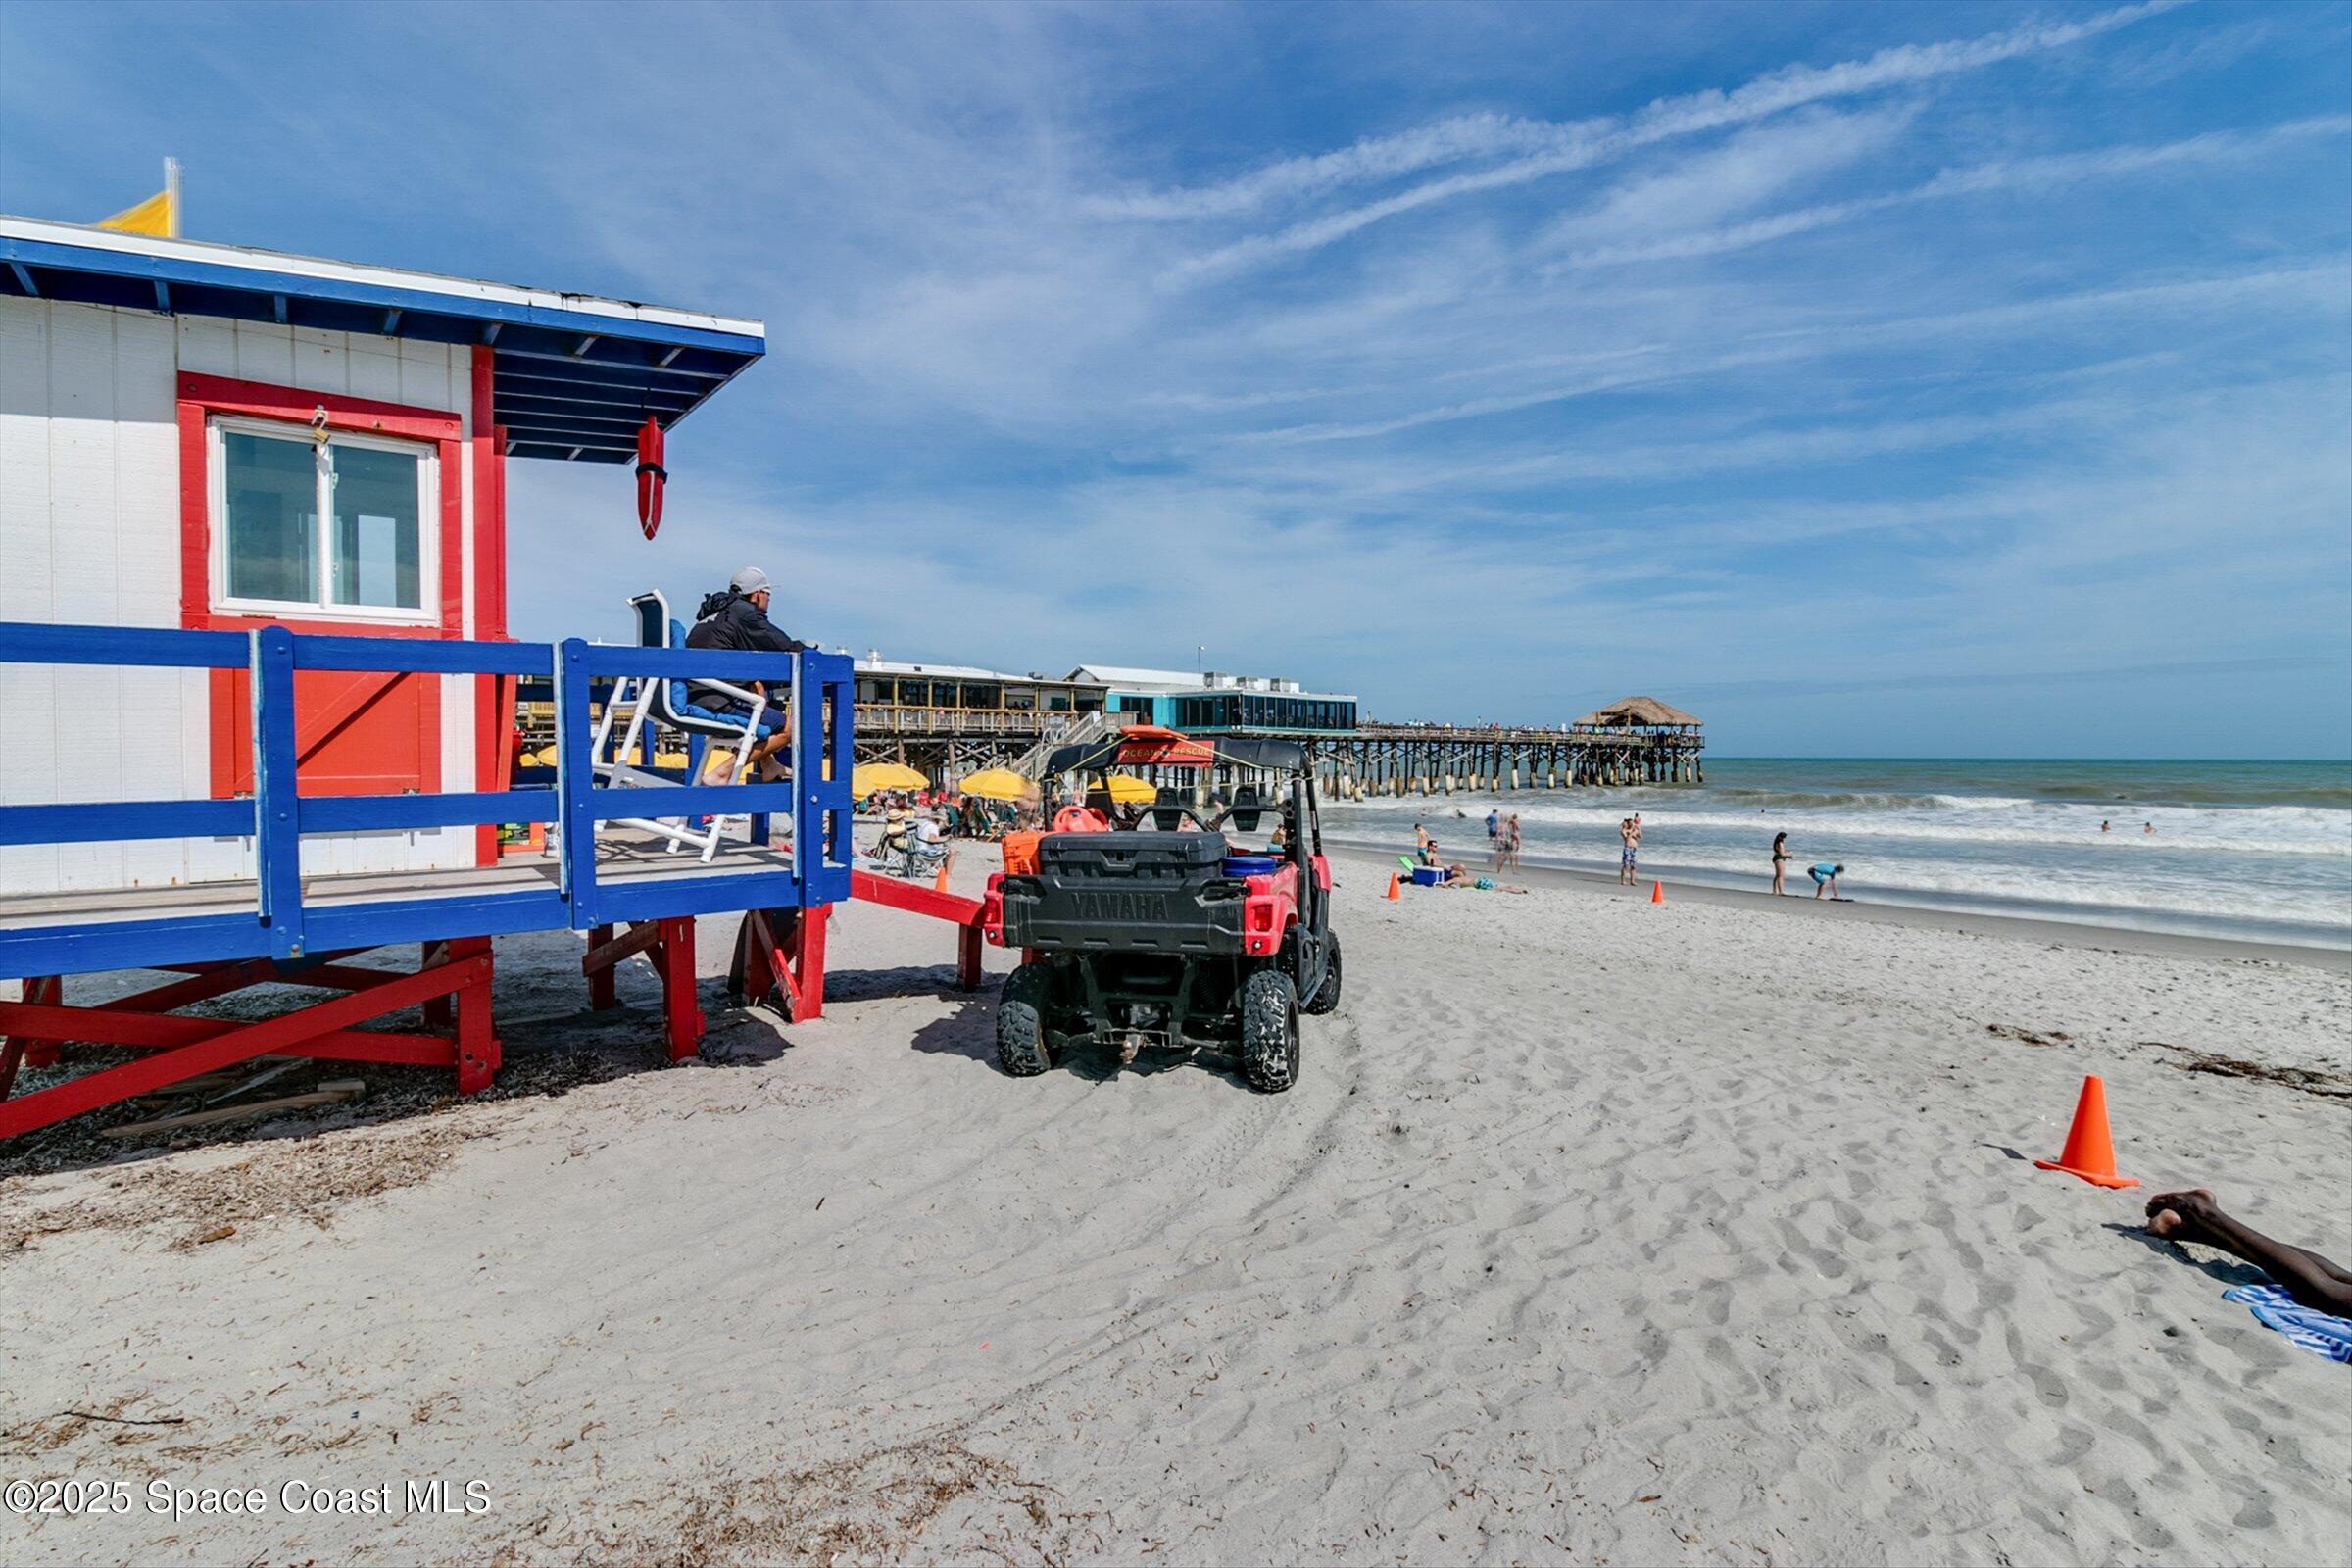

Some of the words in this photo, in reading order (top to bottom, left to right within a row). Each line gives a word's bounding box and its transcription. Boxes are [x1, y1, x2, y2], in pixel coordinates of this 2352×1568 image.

[1122, 748, 1158, 758] OCEAN
[1173, 747, 1210, 757] RESCUE
[1072, 892, 1169, 919] YAMAHA
